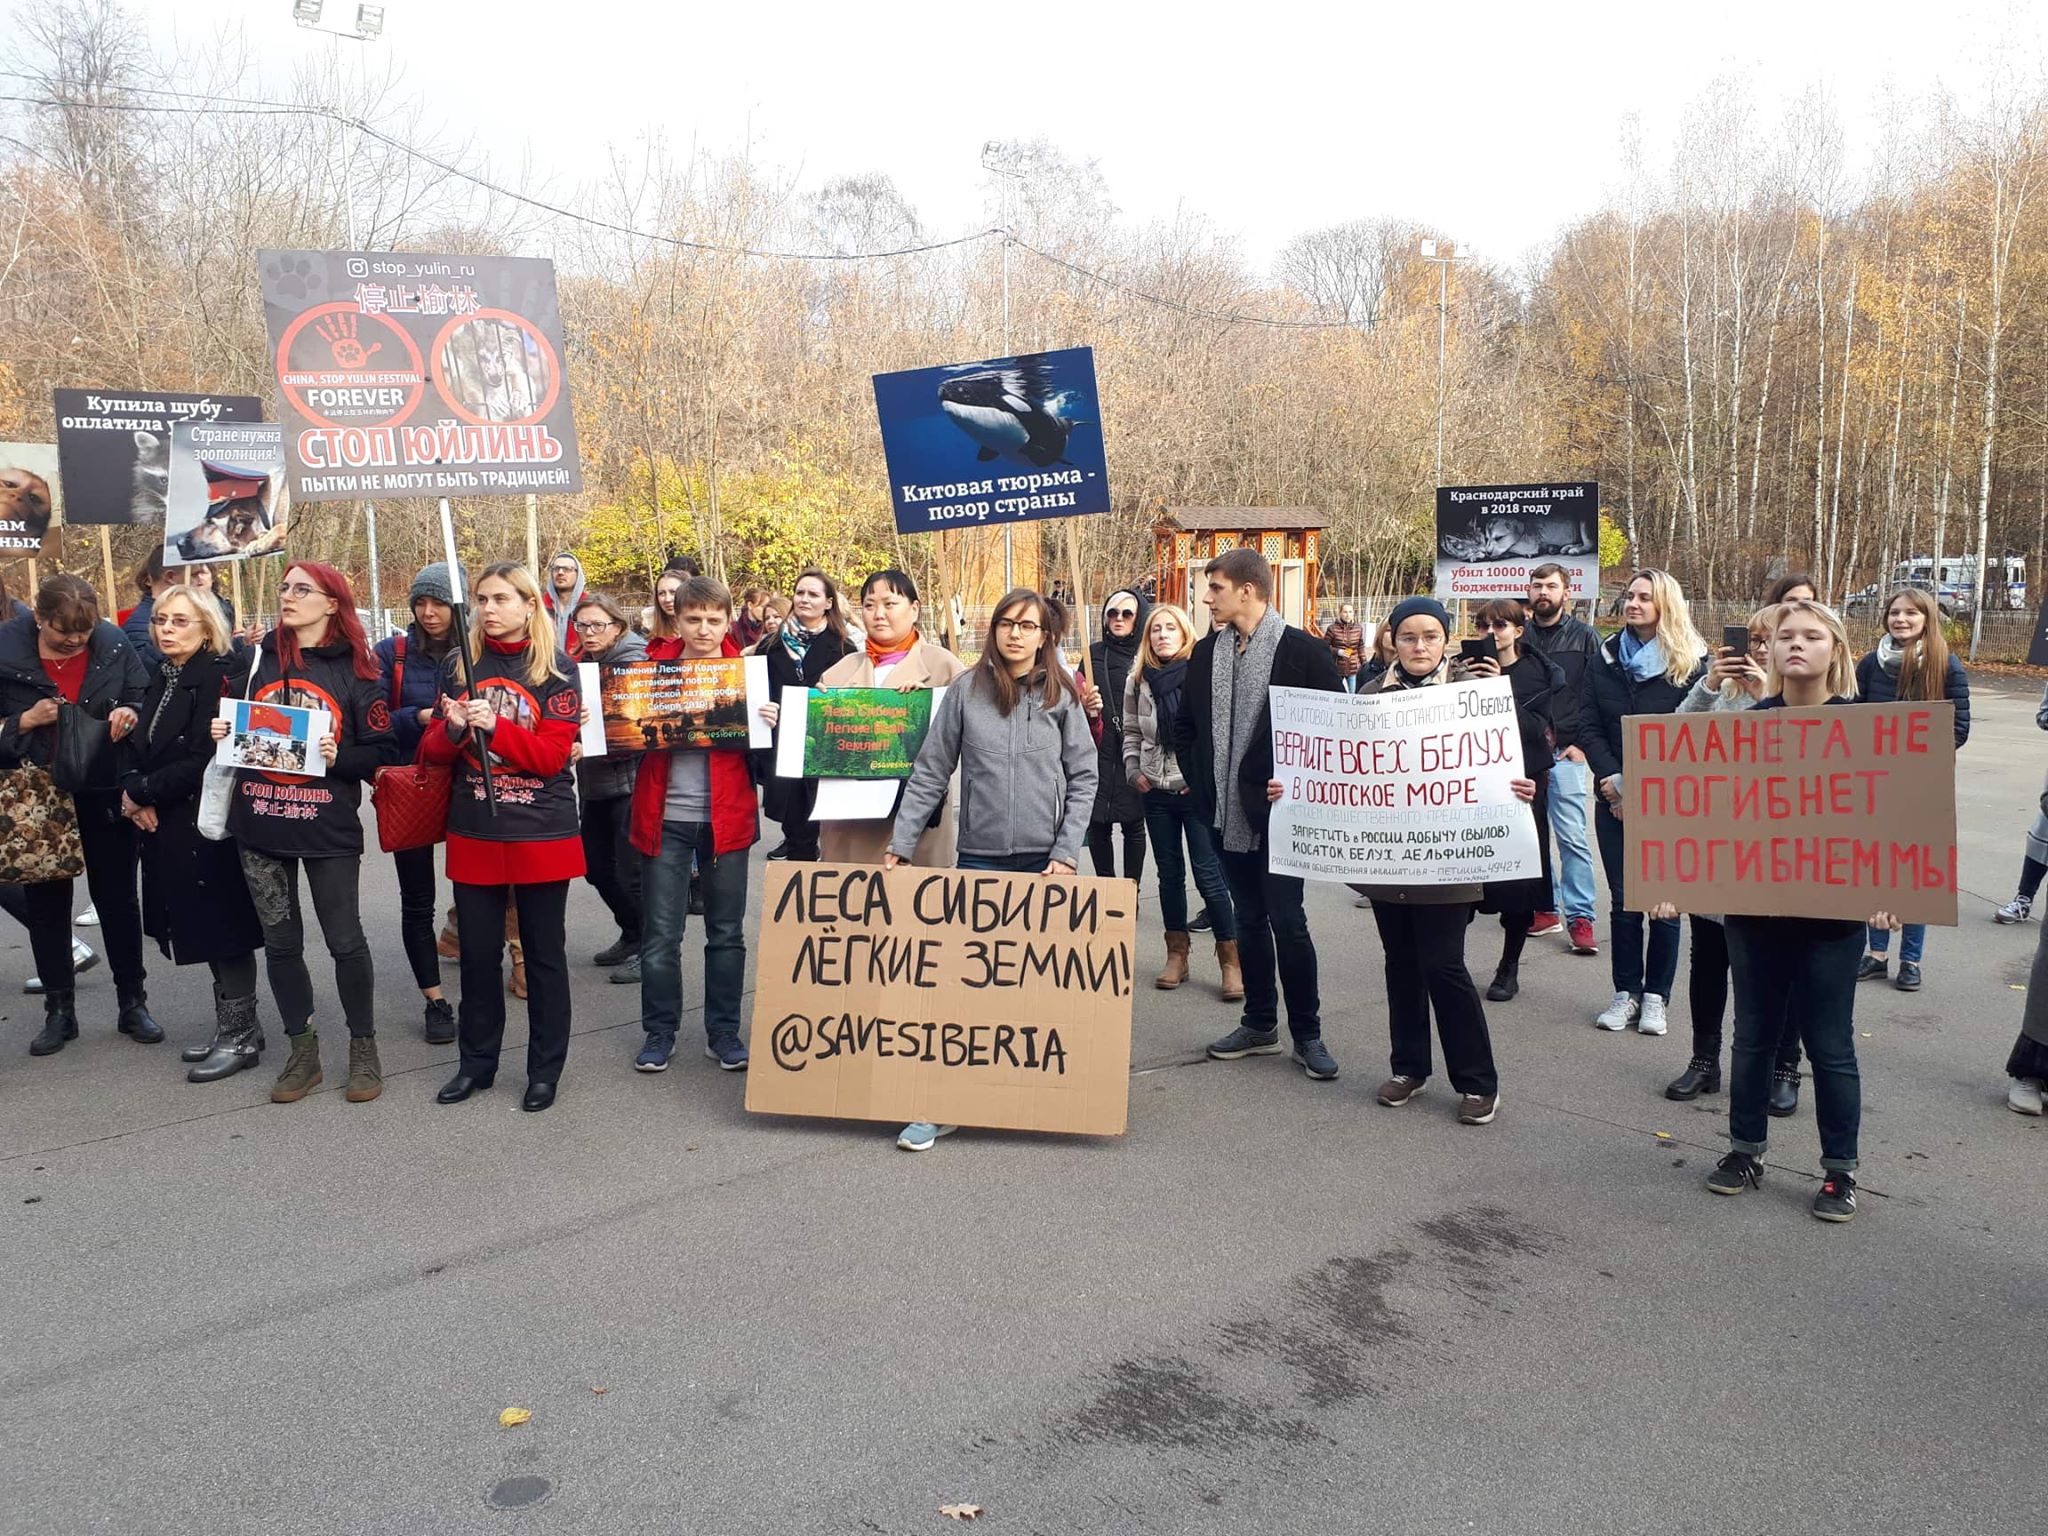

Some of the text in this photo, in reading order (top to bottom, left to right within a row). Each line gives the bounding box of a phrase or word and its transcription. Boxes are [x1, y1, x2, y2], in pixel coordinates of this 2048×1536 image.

[372, 261, 474, 278] stop_yulin_ru
[354, 282, 480, 314] 停止榆林
[283, 374, 422, 385] CHINA, STOP YULIN FESTIVAL
[86, 396, 166, 414] Купила
[170, 398, 222, 418] шубу
[308, 388, 404, 406] FOREVER
[62, 416, 164, 432] оплатила
[191, 427, 281, 450] Стране нужна
[298, 420, 563, 468] СТОП ЮЙЛИНЬ
[194, 448, 276, 463] зоополиция!
[301, 469, 570, 492] ПЫТКИ НЕ МОГУТ БЫТЬ ТРАДИЦИЕЙ!
[902, 479, 993, 502] Китовая
[998, 469, 1082, 494] тюрьма
[1450, 486, 1584, 503] Краснодарский край
[928, 491, 1076, 521] позор страны
[1481, 504, 1552, 516] в 2018 году
[1452, 566, 1484, 580] убил
[1487, 567, 1525, 576] 10000
[1452, 582, 1530, 592] бюджетные
[613, 666, 656, 675] Изменим
[660, 664, 692, 674] Лесной
[695, 664, 728, 674] Кодекс
[633, 677, 718, 687] остановим повтор
[612, 690, 681, 700] экологической
[858, 704, 908, 718] Сибири
[1276, 696, 1286, 720] В
[1336, 712, 1391, 730] ТЮРЬМЕ
[1458, 690, 1480, 718] 50
[1481, 695, 1512, 716] БЕЛУХ
[688, 730, 746, 741] @savesiberia
[1639, 711, 1931, 764] ПЛАНЕТА НЕ
[1275, 727, 1513, 775] ВЕРНИТЕ ВСЕХ БЕЛУХ
[870, 760, 914, 770] @savesiber
[242, 780, 334, 803] СТОП ЮЙЛИНЬ
[1292, 776, 1478, 807] В ОХОТСКОЕ МОРЕ
[1640, 770, 1889, 821] ПОГИБНЕТ
[1292, 824, 1350, 842] ЗАПРЕТИТЬ
[1362, 831, 1404, 844] РОССИИ
[1406, 830, 1456, 844] ДОБЫЧУ
[1461, 825, 1510, 842] (ВЫЛОВ)
[1350, 848, 1396, 862] БЕЛУХ,
[1402, 845, 1495, 861] ДЕЛЬФИНОВ
[1641, 837, 1958, 894] ПОГИБНЕМ МЫ
[774, 870, 892, 927] ЛЕСА
[792, 926, 1131, 997] ЛЁГКИЕ ЗЕМЛИ!
[771, 1012, 1067, 1074] @SAVESIBERIA
